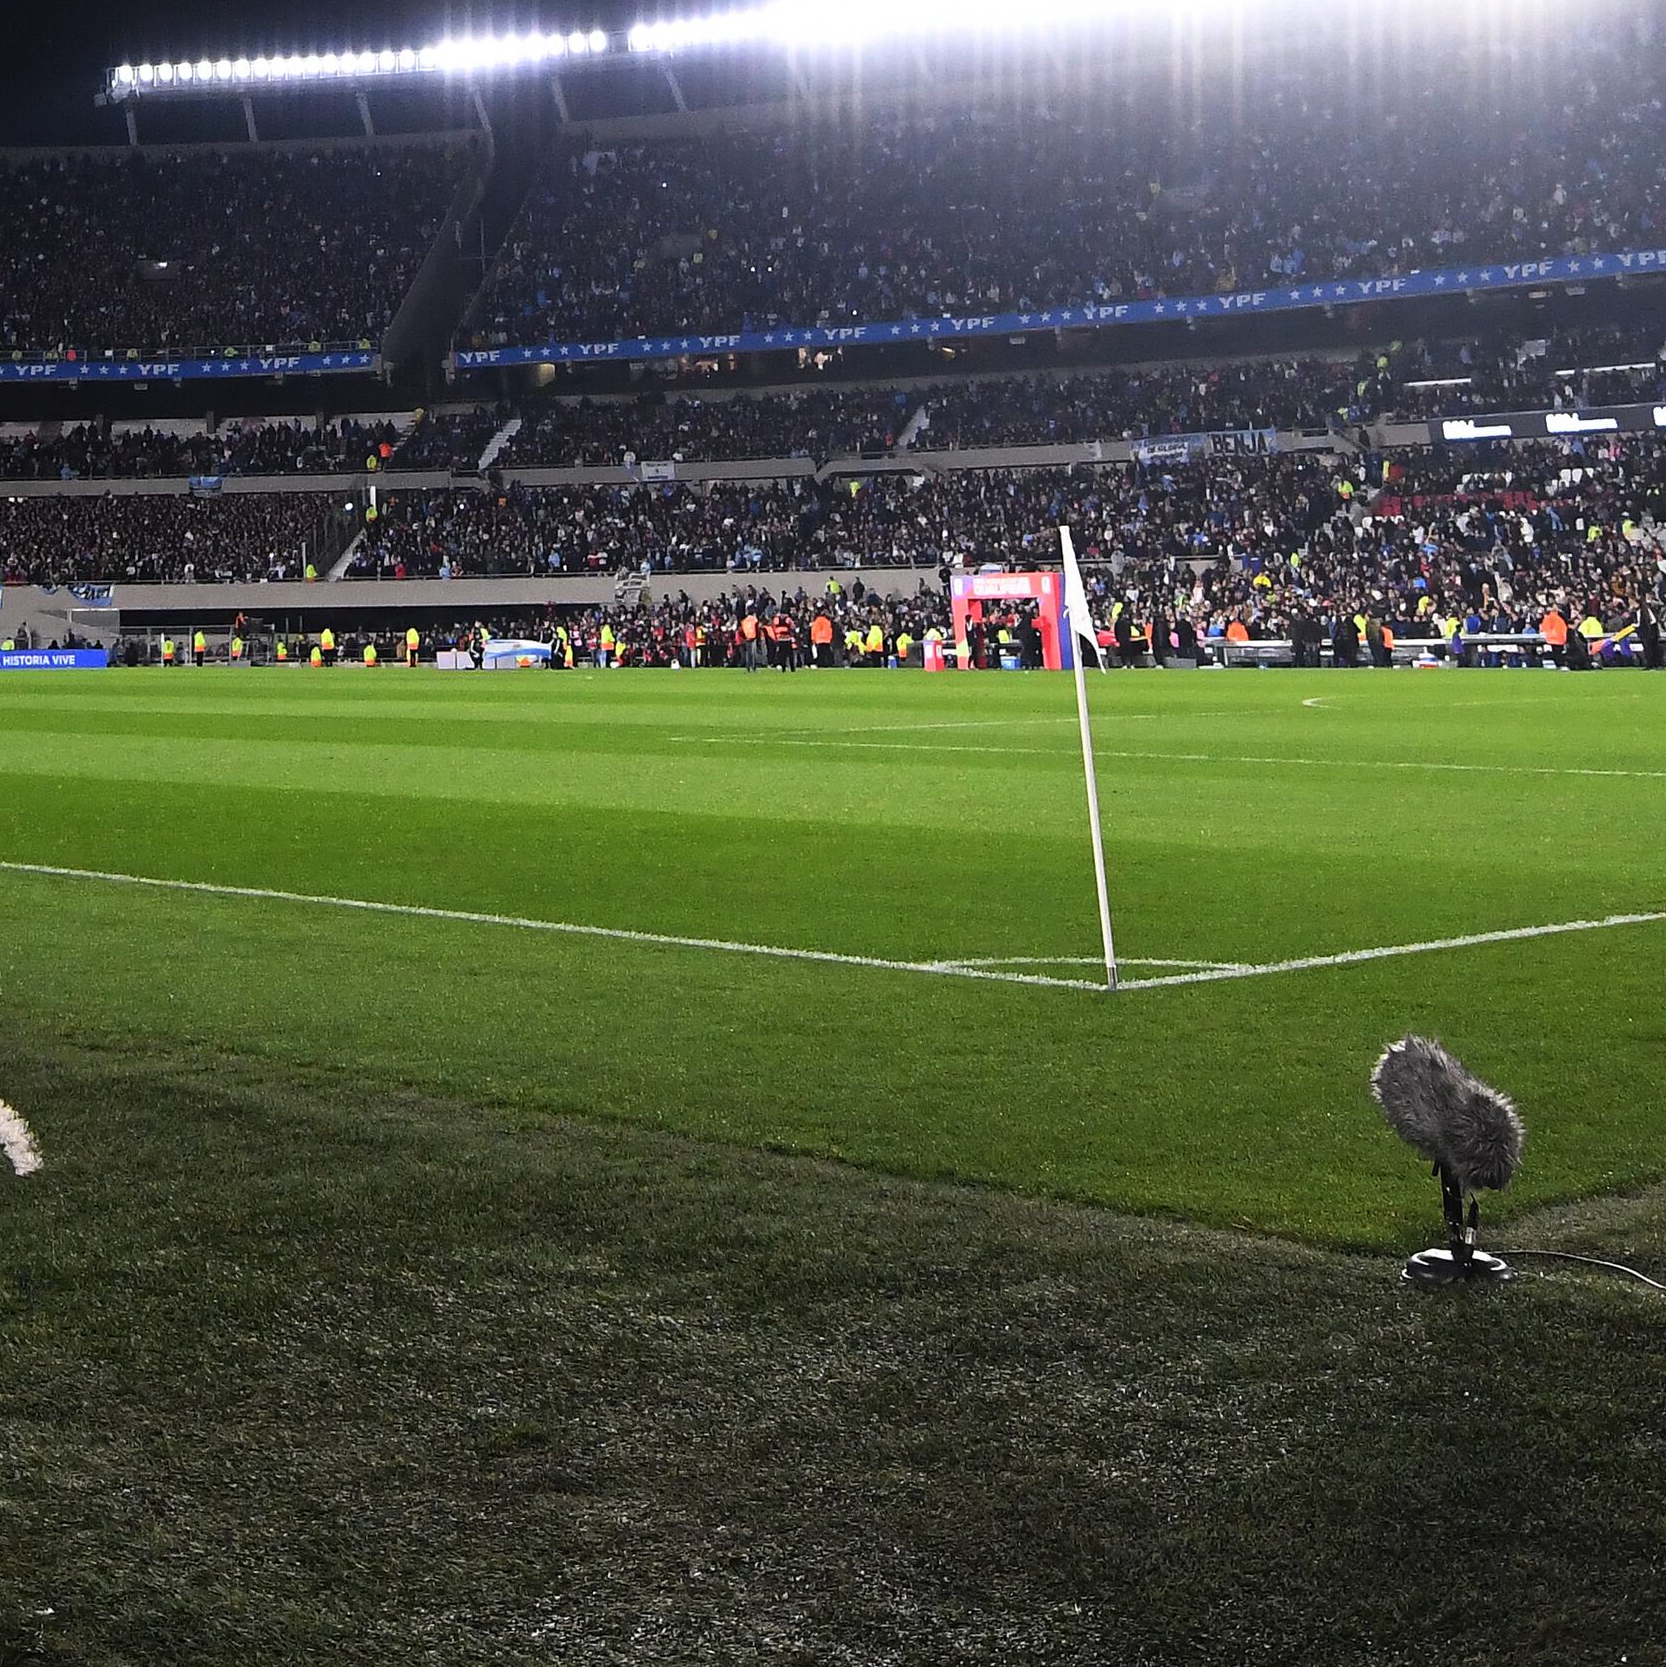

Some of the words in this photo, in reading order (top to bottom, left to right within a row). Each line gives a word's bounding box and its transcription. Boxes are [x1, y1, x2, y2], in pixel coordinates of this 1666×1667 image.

[1503, 261, 1553, 279] YPF
[1358, 279, 1405, 293] YPF
[1219, 293, 1266, 308] YPF
[1084, 305, 1128, 319] YPF
[952, 317, 994, 330] YPF
[825, 327, 866, 340] YPF
[700, 336, 740, 348] YPF
[580, 344, 618, 354] YPF
[260, 357, 300, 369] YPF
[461, 351, 500, 363] YPF
[16, 365, 56, 375] YPF
[138, 364, 179, 375] YPF
[1212, 432, 1269, 454] BENJA
[3, 655, 50, 666] HISTORIA
[52, 655, 76, 665] VIVE
